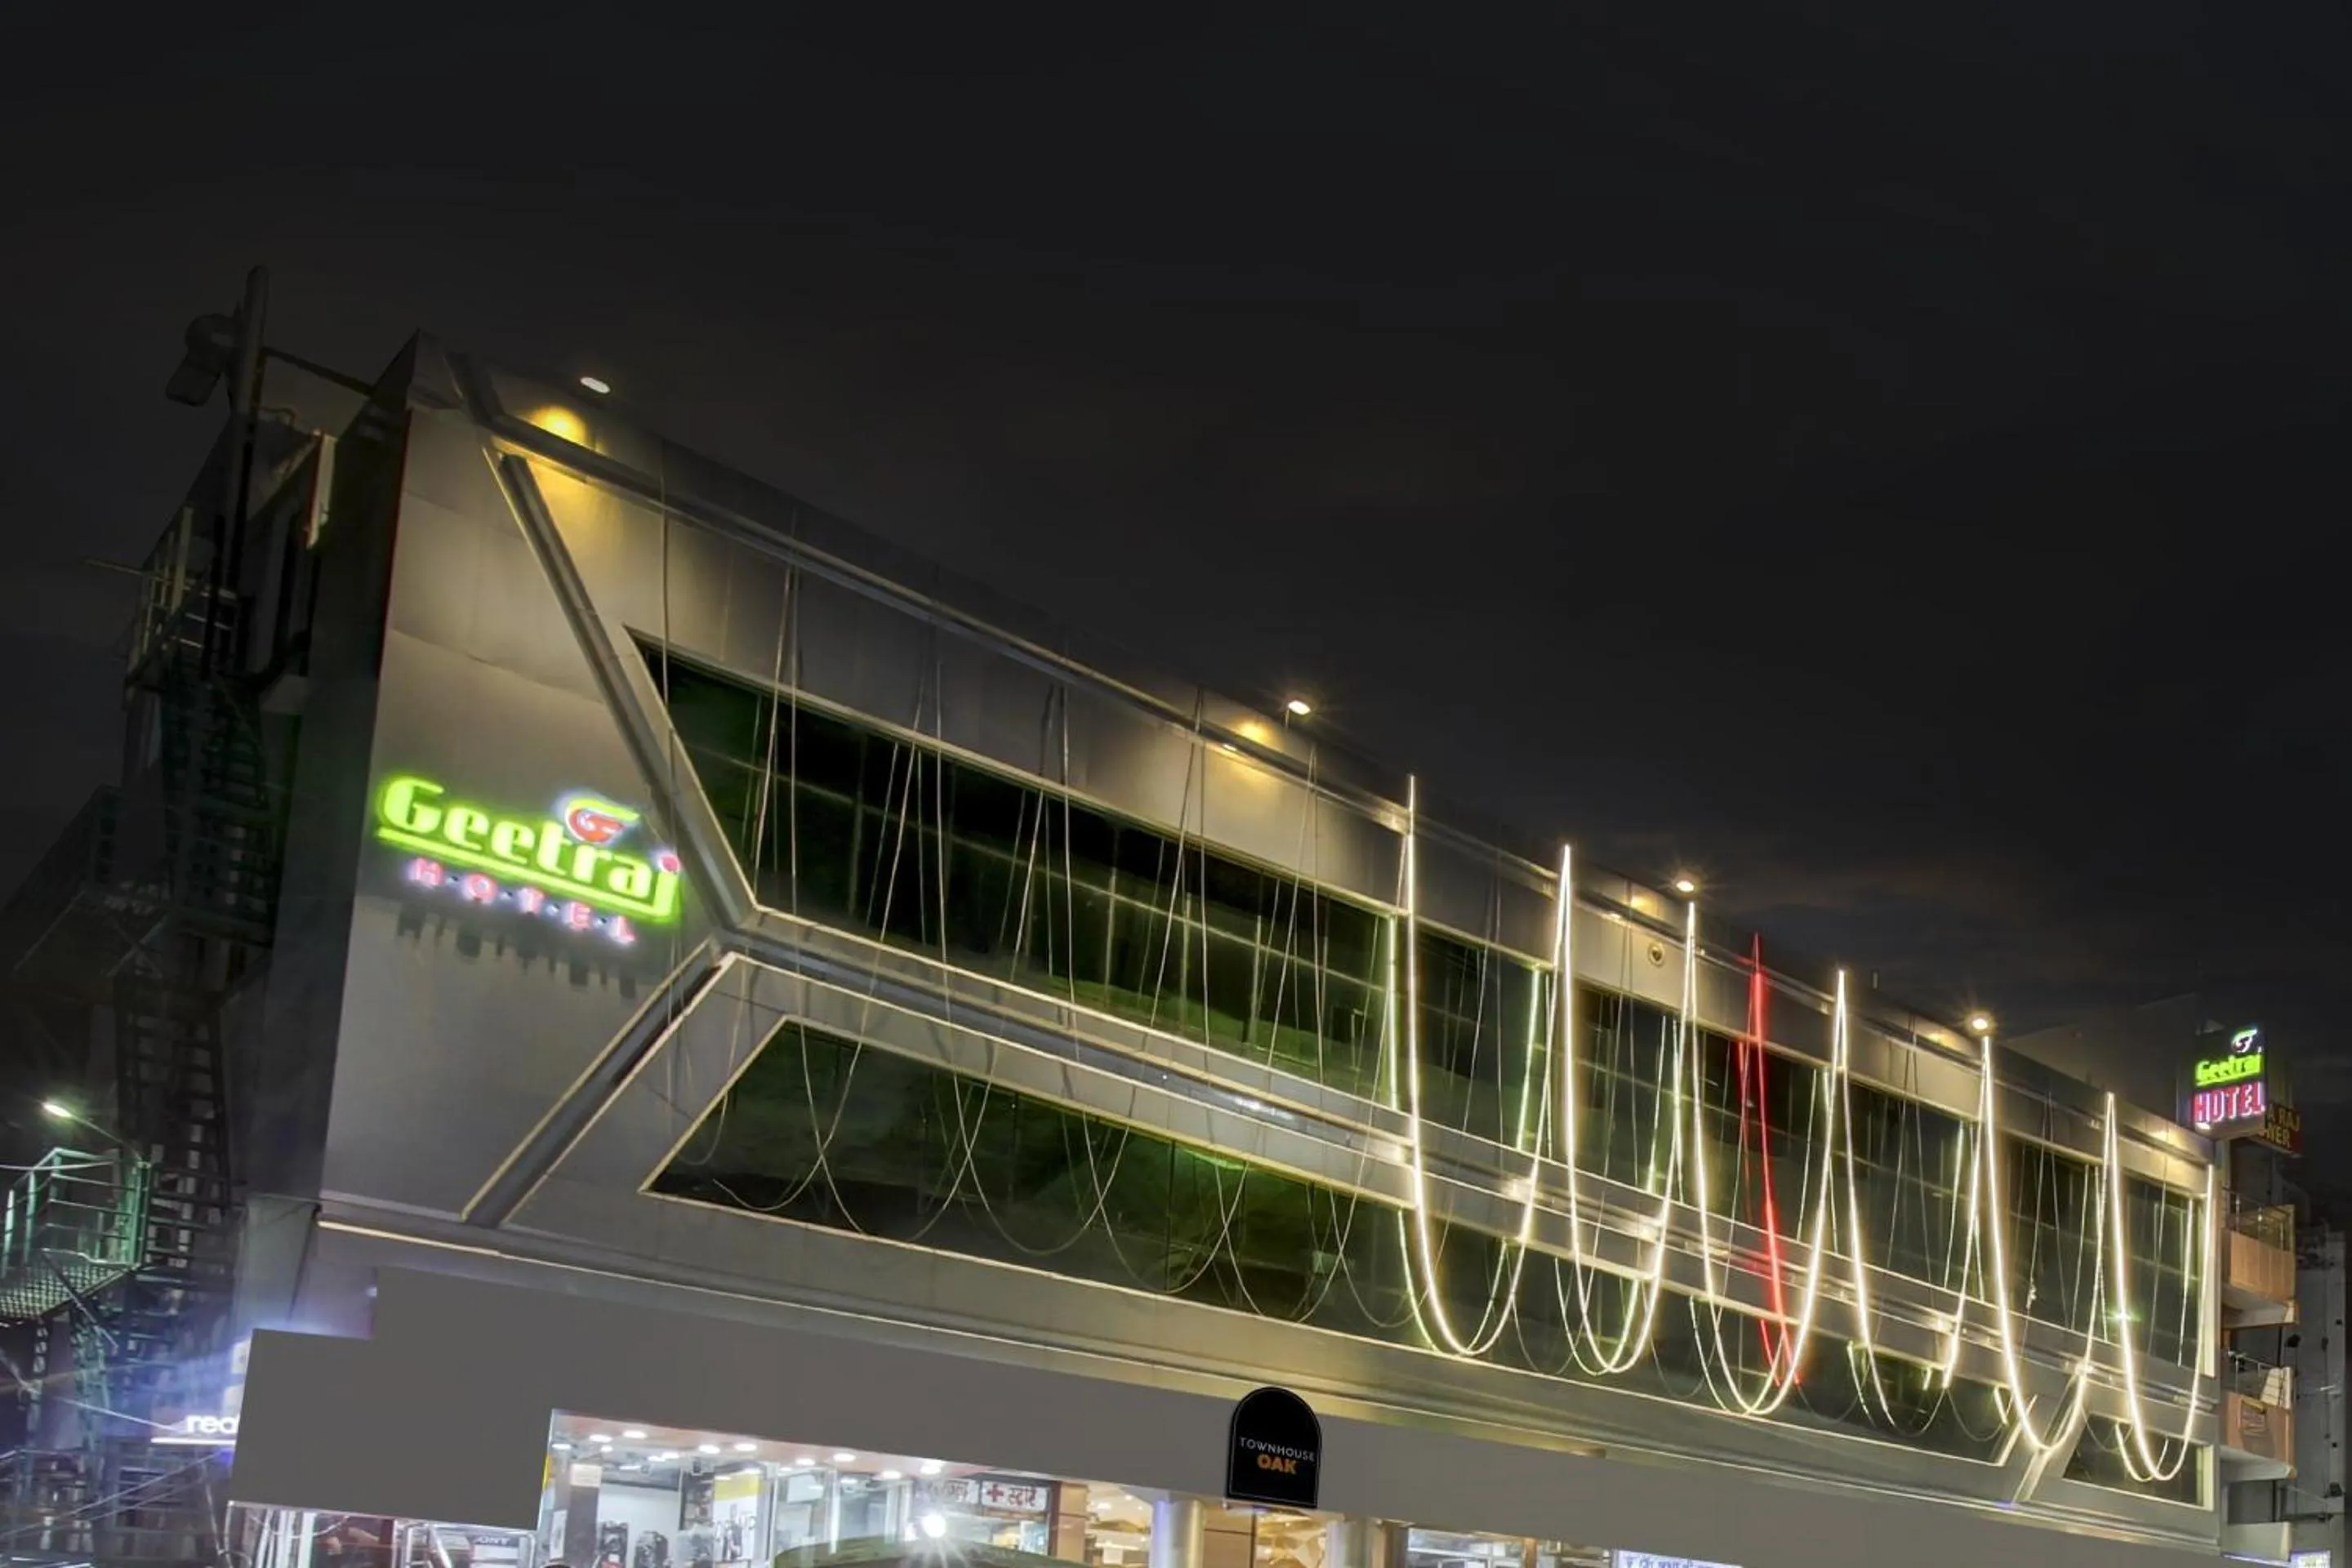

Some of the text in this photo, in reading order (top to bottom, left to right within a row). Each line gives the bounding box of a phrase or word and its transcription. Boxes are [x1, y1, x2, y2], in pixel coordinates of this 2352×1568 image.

[377, 776, 681, 916] Geetraj
[408, 858, 636, 944] HOTEL
[2194, 1082, 2265, 1123] HOTEL
[1240, 1437, 1315, 1462] TOWNHOUSE
[1257, 1454, 1297, 1475] OAK
